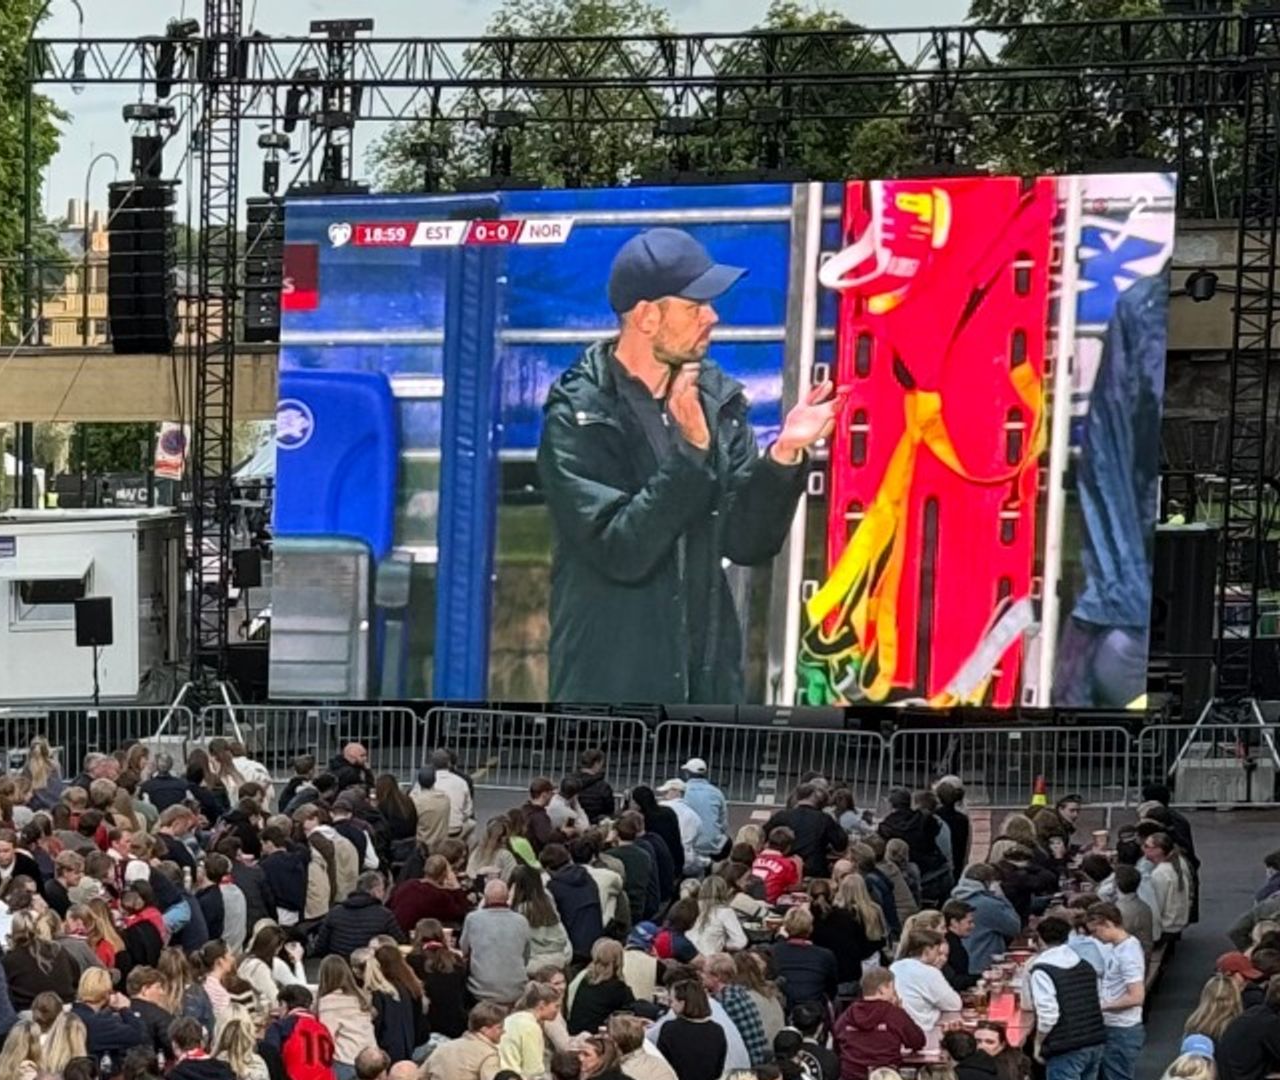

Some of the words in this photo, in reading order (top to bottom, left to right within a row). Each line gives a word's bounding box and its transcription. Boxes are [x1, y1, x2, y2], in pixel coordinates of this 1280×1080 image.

[364, 227, 407, 243] 18:59
[425, 229, 453, 241] EST
[529, 224, 561, 238] NOR
[299, 1030, 334, 1068] 10
